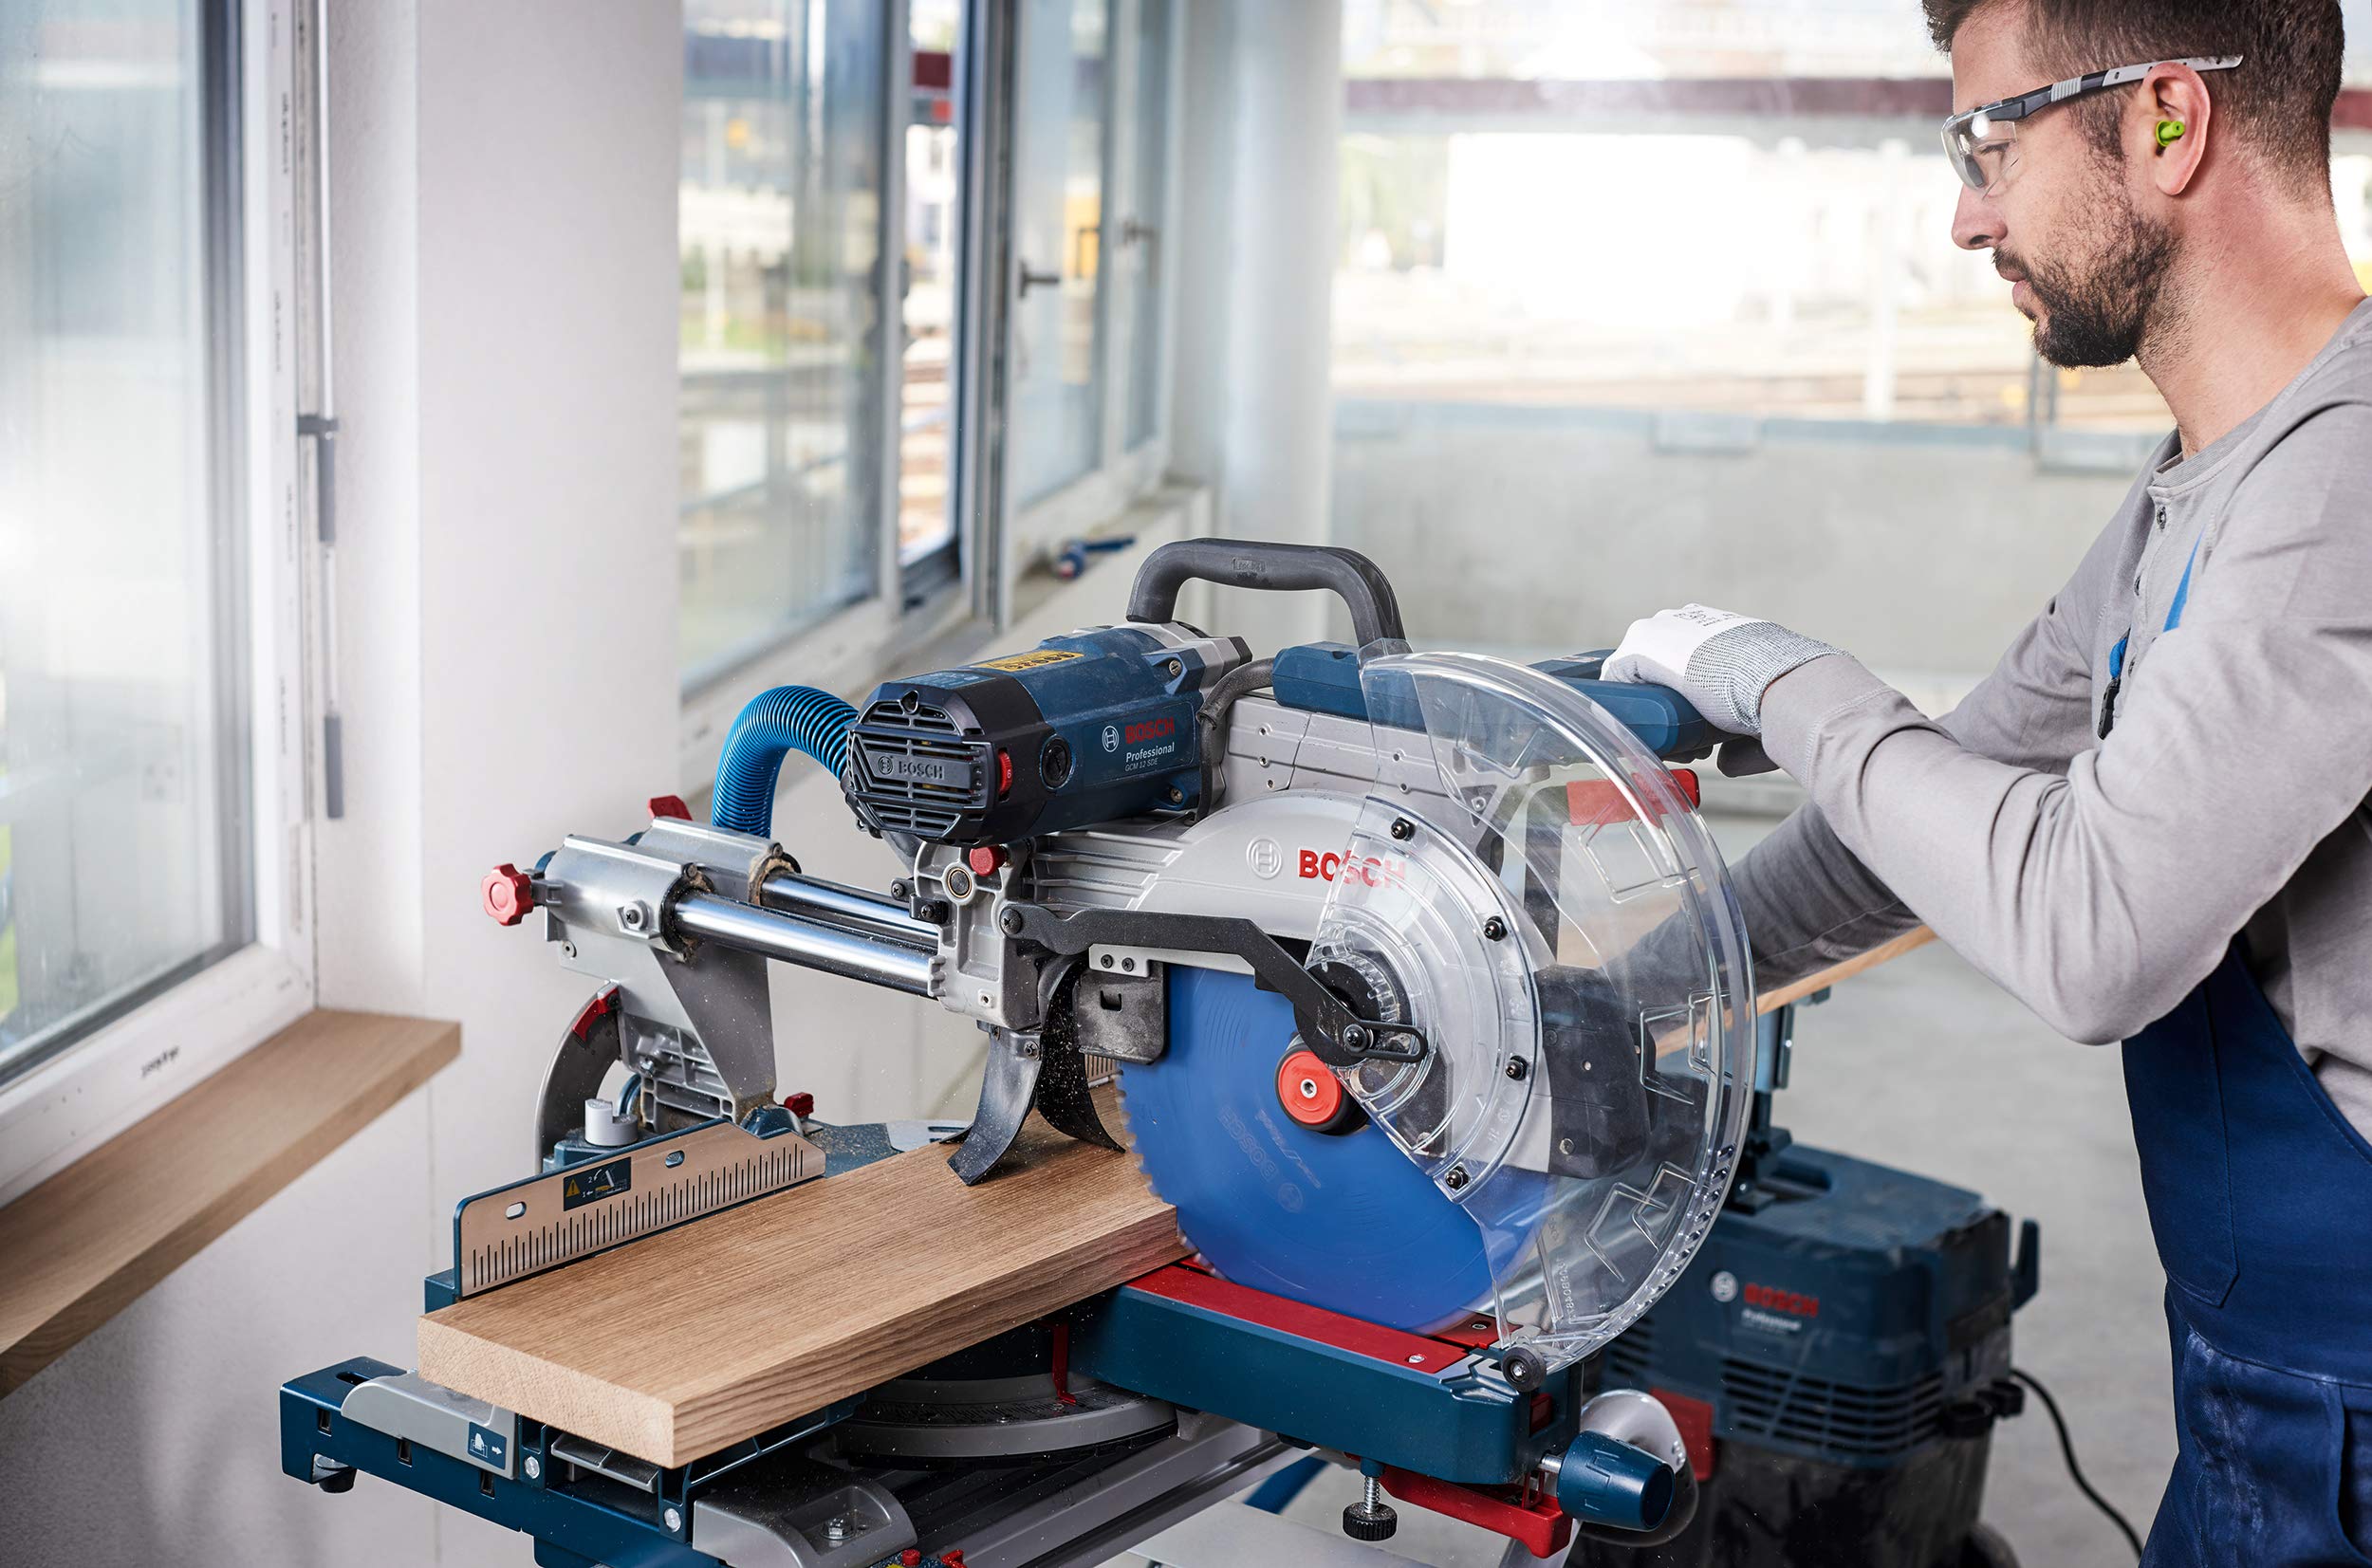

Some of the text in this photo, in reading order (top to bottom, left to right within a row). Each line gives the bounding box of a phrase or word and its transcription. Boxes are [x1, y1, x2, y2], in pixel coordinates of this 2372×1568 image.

[1125, 717, 1176, 745] BOSCH
[1124, 757, 1158, 772] GCM 12 SDE
[1125, 741, 1176, 763] Professional
[899, 760, 945, 780] BOSCH
[1299, 849, 1405, 888] BOSCH
[1744, 1282, 1821, 1319] BOSCH
